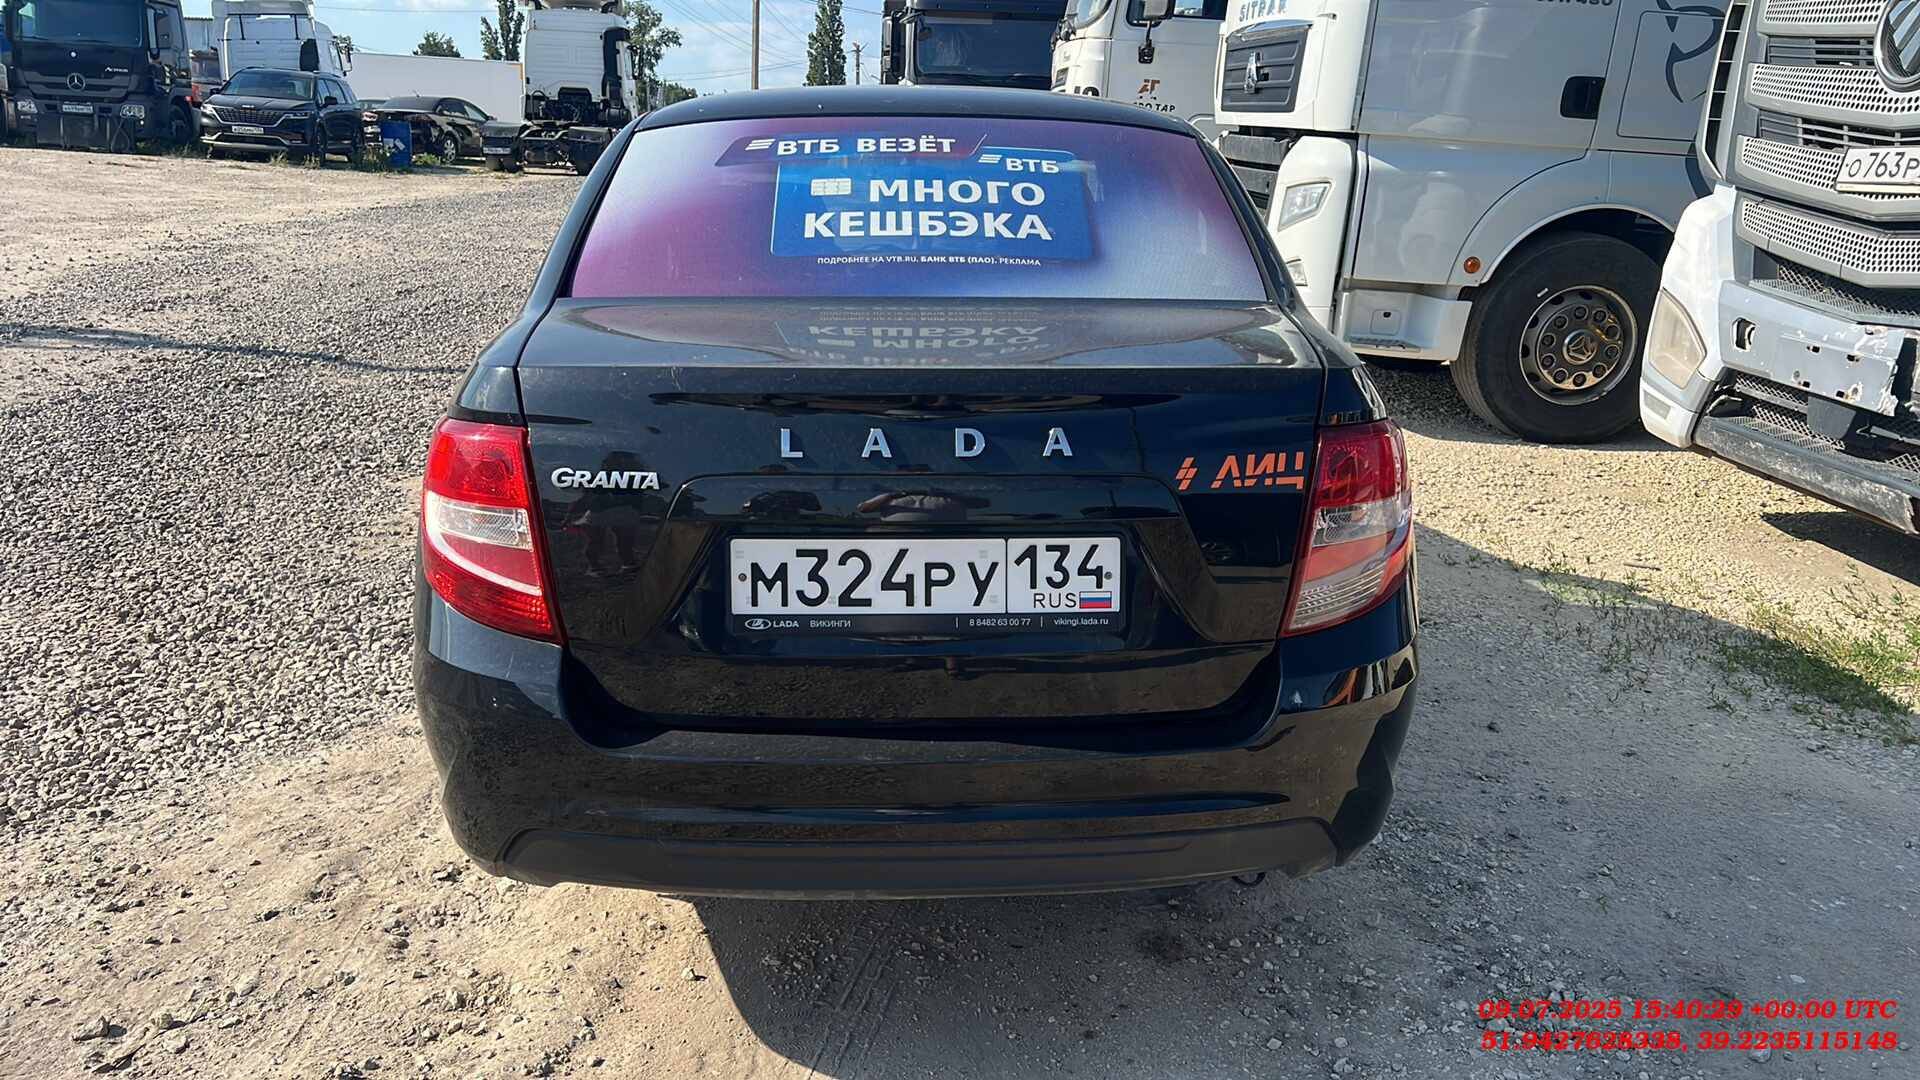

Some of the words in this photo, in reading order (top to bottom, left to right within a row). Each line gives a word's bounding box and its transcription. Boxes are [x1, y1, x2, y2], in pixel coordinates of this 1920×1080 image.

[1239, 0, 1288, 22] SITRAK
[777, 138, 840, 155] ВТБ
[856, 135, 956, 153] ВЕЗЁТ
[1006, 158, 1060, 174] ВТБ
[1847, 151, 1920, 178] О763Р
[869, 179, 1046, 206] МНОГО
[804, 211, 1053, 241] КЕШБЭКА
[817, 256, 870, 265] ПОДРОБНЕЕ
[920, 255, 946, 263] БАНК
[999, 257, 1041, 266] РЕКЛАМА
[780, 427, 1073, 458] LADA
[550, 467, 660, 490] GRANTA
[1210, 451, 1305, 490] ЛИЦ
[750, 548, 999, 608] М324РУ
[1014, 544, 1104, 590] 134
[1033, 591, 1077, 609] RUS
[772, 619, 800, 628] LADA
[809, 619, 852, 628] ВИКИНГИ
[969, 618, 975, 626] 8
[976, 618, 997, 626] 8482
[998, 618, 1008, 626] 63
[1009, 618, 1020, 626] 00
[1021, 618, 1032, 626] 77
[1053, 617, 1109, 627] vikingi.lada.ru
